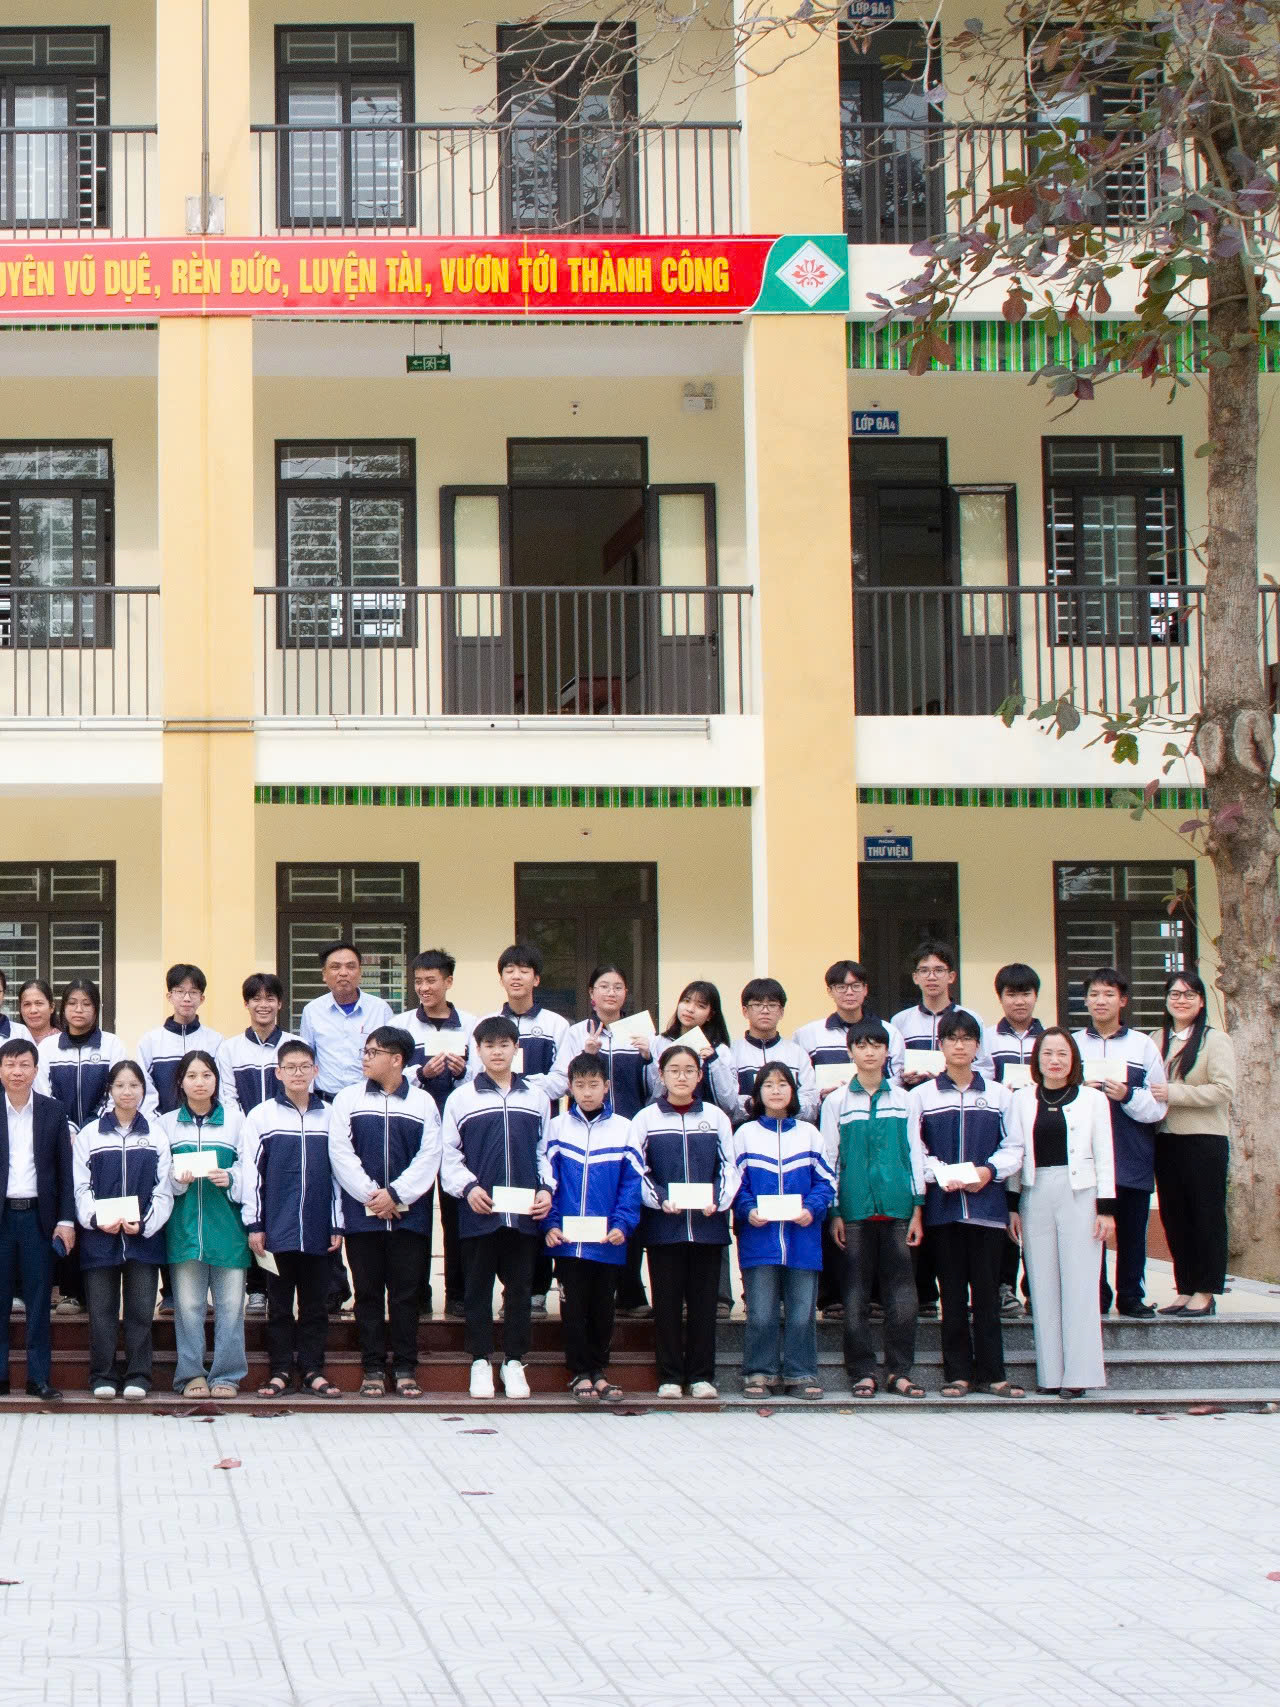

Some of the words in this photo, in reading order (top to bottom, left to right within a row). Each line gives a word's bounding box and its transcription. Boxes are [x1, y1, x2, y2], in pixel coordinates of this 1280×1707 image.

[63, 253, 96, 296] VŨ
[172, 250, 221, 294] RÈN
[230, 250, 289, 298] ĐỨC,
[299, 250, 377, 301] LUYỆN
[385, 250, 432, 298] TÀI,
[440, 253, 509, 294] VƯƠN
[518, 249, 558, 294] TỚI
[567, 249, 653, 294] THÀNH
[661, 249, 730, 294] CÔNG
[855, 413, 875, 431] LỚP
[875, 415, 896, 431] 6A4
[867, 845, 887, 857] THƯ
[886, 844, 909, 859] VIỆN
